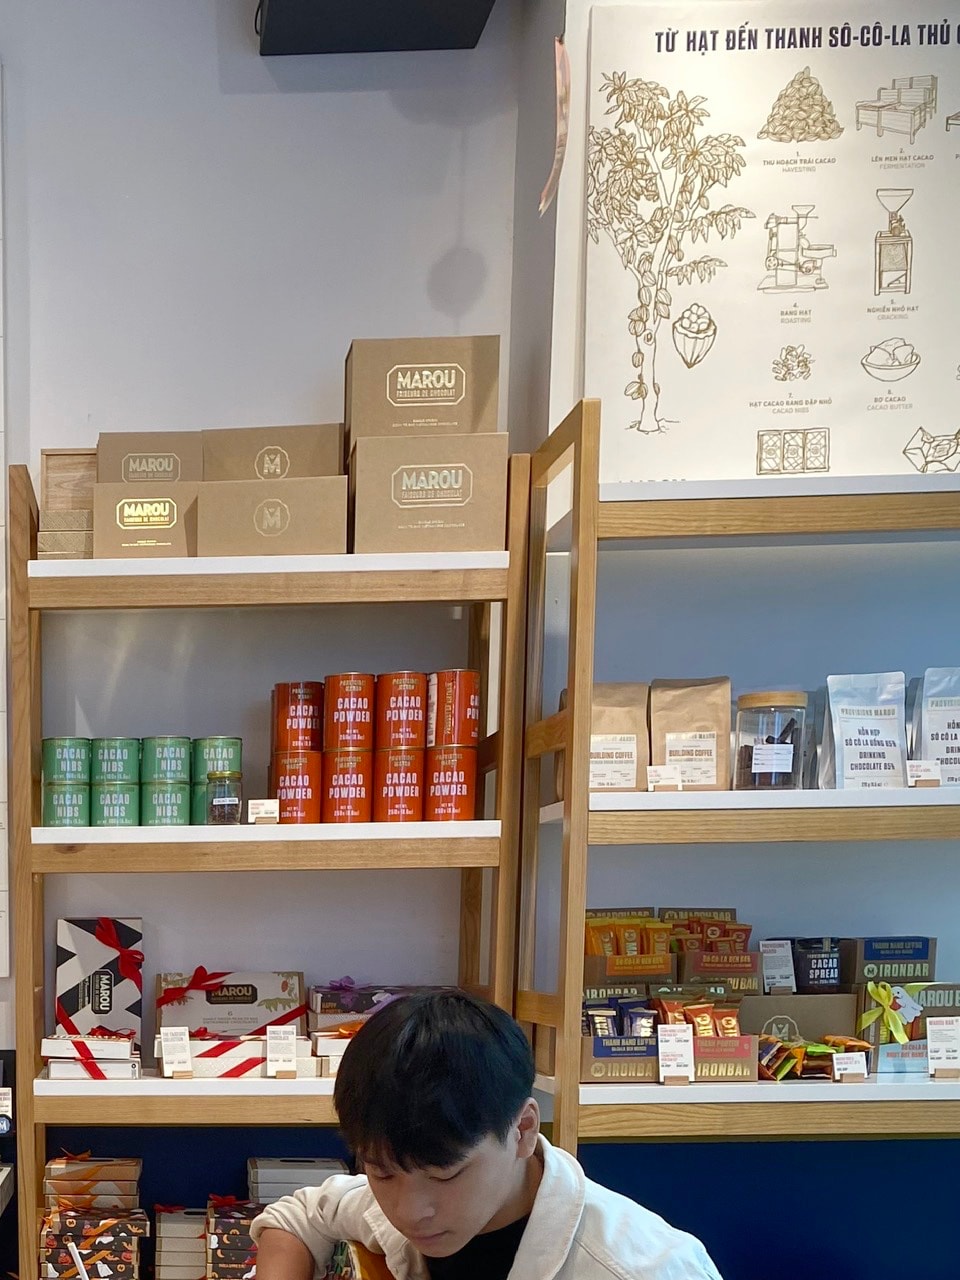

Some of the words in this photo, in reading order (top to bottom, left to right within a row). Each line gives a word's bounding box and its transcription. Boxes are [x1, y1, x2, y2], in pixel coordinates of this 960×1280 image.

[655, 28, 678, 52] TỪ
[687, 30, 719, 56] HẠT
[726, 21, 758, 51] ĐẾN
[765, 27, 822, 50] THANH
[828, 22, 911, 47] SÔ-CÔ-LA
[917, 18, 951, 46] THỦ
[397, 370, 455, 389] MAROU
[128, 457, 173, 472] MAROU
[401, 470, 463, 490] MAROU
[123, 502, 169, 517] MAROU
[337, 698, 368, 709] CACAO
[390, 696, 421, 708] CACAO
[334, 711, 370, 723] POWDER
[386, 709, 423, 722] POWDER
[56, 749, 85, 760] CACAO
[98, 749, 128, 760] CACAO
[156, 748, 185, 758] CACAO
[204, 748, 233, 759] CACAO
[669, 749, 694, 757] BUILDING
[695, 749, 713, 757] COFFEE
[60, 761, 82, 772] NIBS
[102, 761, 124, 772] NIBS
[160, 760, 182, 771] NIBS
[207, 761, 229, 771] NIBS
[279, 775, 309, 786] CACAO
[332, 774, 363, 785] CACAO
[386, 772, 417, 784] CACAO
[433, 771, 465, 783] CACAO
[277, 788, 312, 800] POWDER
[329, 787, 365, 799] POWDER
[383, 786, 419, 798] POWDER
[430, 784, 467, 796] POWDER
[53, 794, 82, 805] CACAO
[100, 794, 130, 805] CACAO
[153, 793, 181, 804] CACAO
[57, 806, 79, 817] NIBS
[104, 806, 125, 817] NIBS
[156, 806, 178, 817] NIBS
[811, 958, 838, 968] CACAO
[809, 969, 838, 979] SPREAD
[879, 963, 929, 977] IRONBAR
[740, 977, 758, 990] BAR
[100, 975, 111, 1011] MAROU
[914, 990, 954, 1007] AROU
